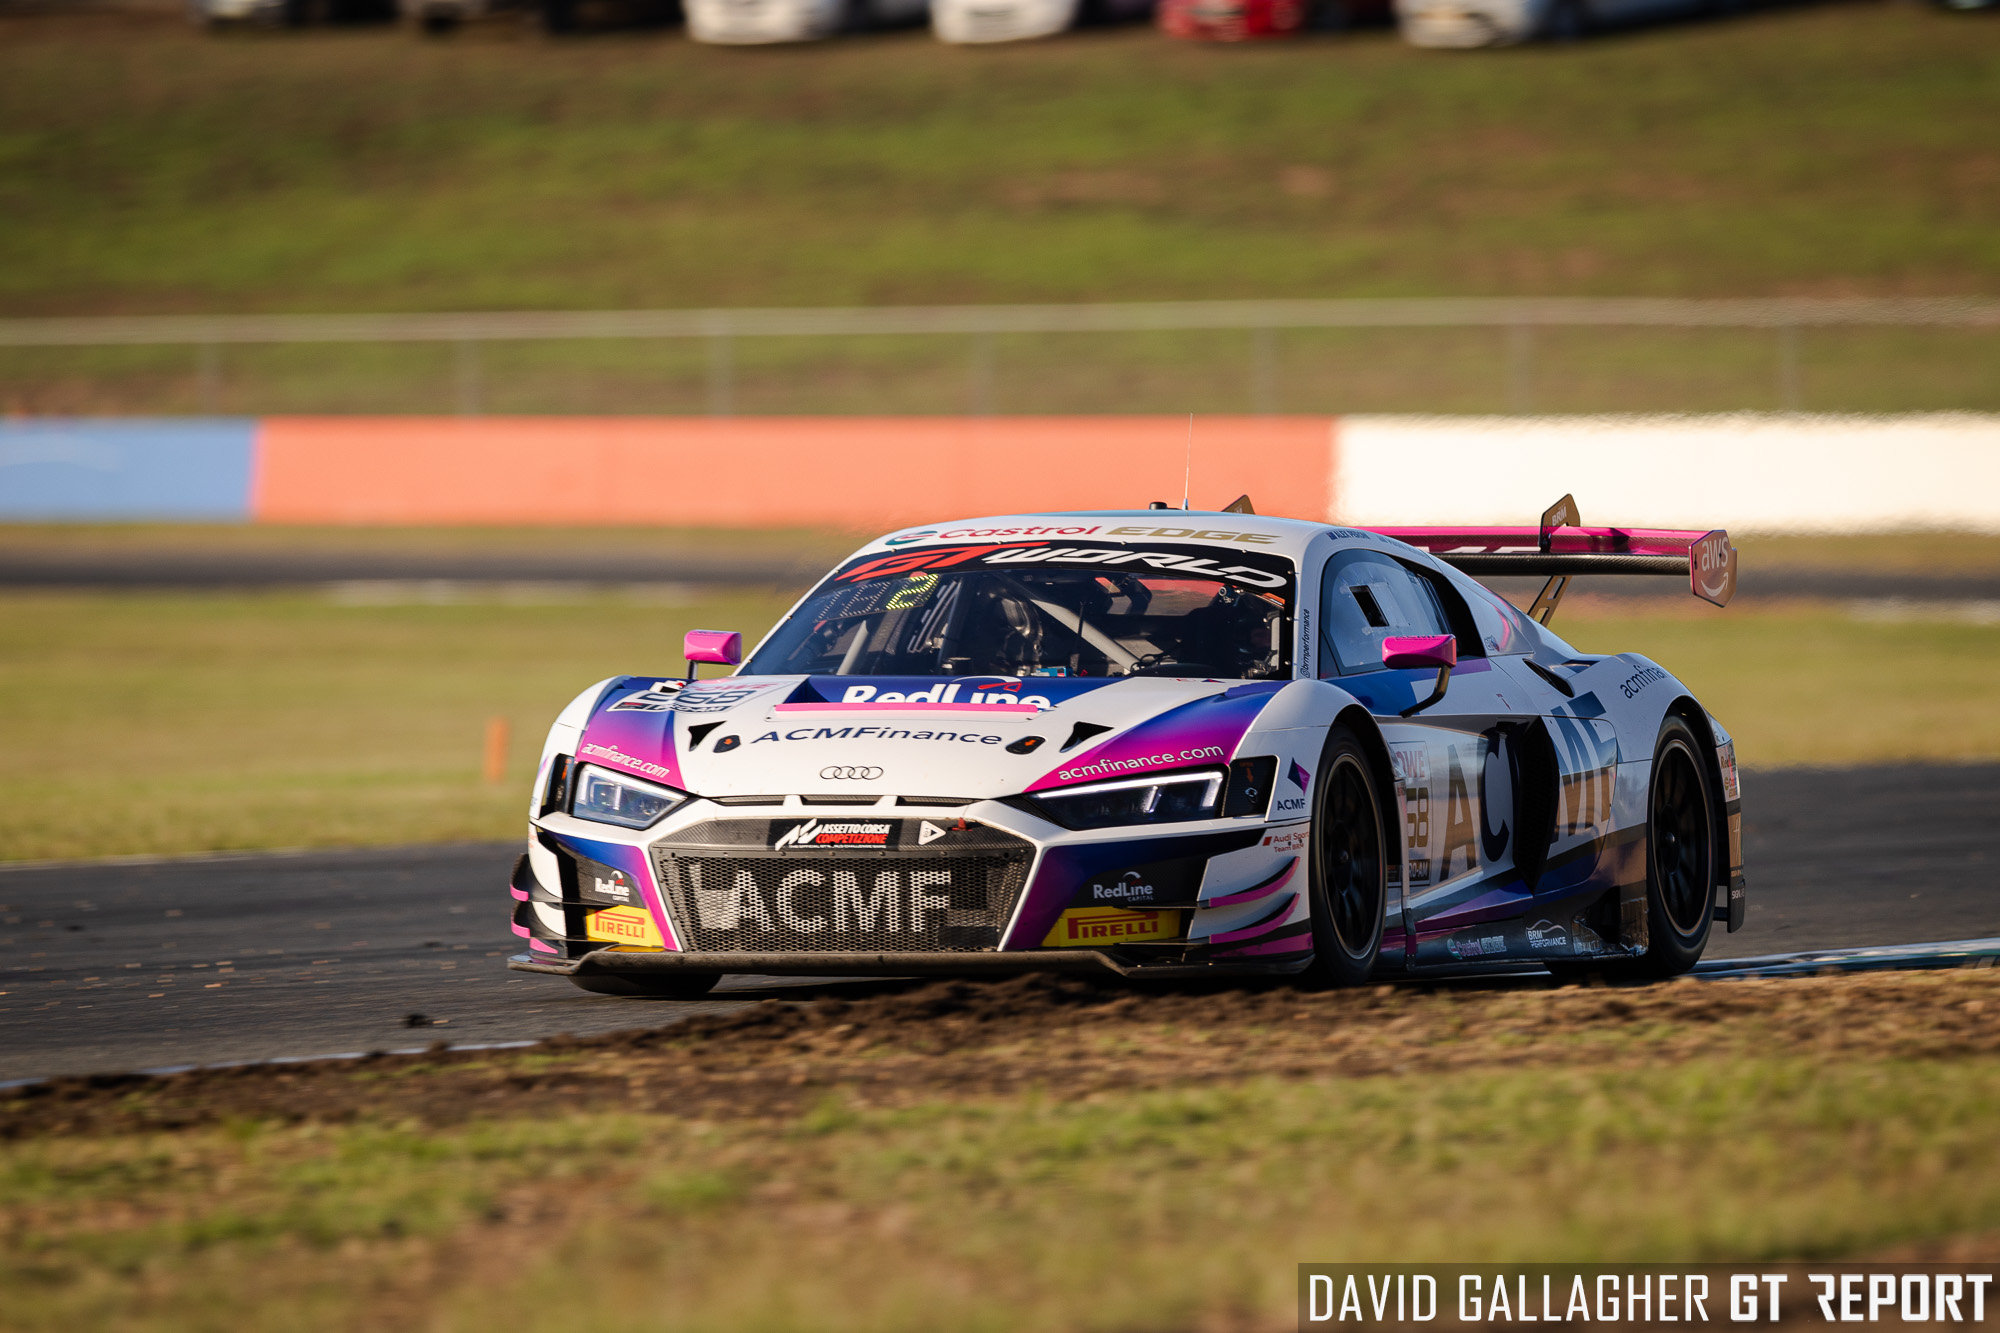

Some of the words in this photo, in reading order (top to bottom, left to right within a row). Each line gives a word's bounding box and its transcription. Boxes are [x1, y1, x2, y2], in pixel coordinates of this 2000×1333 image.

[1552, 506, 1567, 527] BRM
[938, 525, 1101, 541] Castrol
[1106, 525, 1282, 545] EDGE
[1701, 536, 1729, 572] aws
[834, 541, 1050, 583] GT
[981, 547, 1288, 589] WORLD
[1300, 608, 1310, 678] @brmperformance
[841, 683, 1050, 710] RedLine
[750, 726, 1003, 745] ACMFinance
[581, 743, 670, 778] acmfinance.com
[1058, 745, 1225, 781] acmfinance.com
[1277, 799, 1306, 811] ACMF
[815, 834, 889, 844] COMPETIZIONE
[820, 824, 860, 834] ASSETTO
[860, 824, 891, 834] CORSA
[1273, 834, 1292, 843] Audi
[1274, 845, 1292, 853] Team
[1093, 882, 1153, 899] RedLine
[732, 869, 952, 934] ACMF
[595, 910, 646, 939] PIRELLI
[1067, 911, 1159, 940] PIRELLI
[1527, 930, 1543, 940] BRM
[1530, 936, 1567, 948] PERFORMANCE
